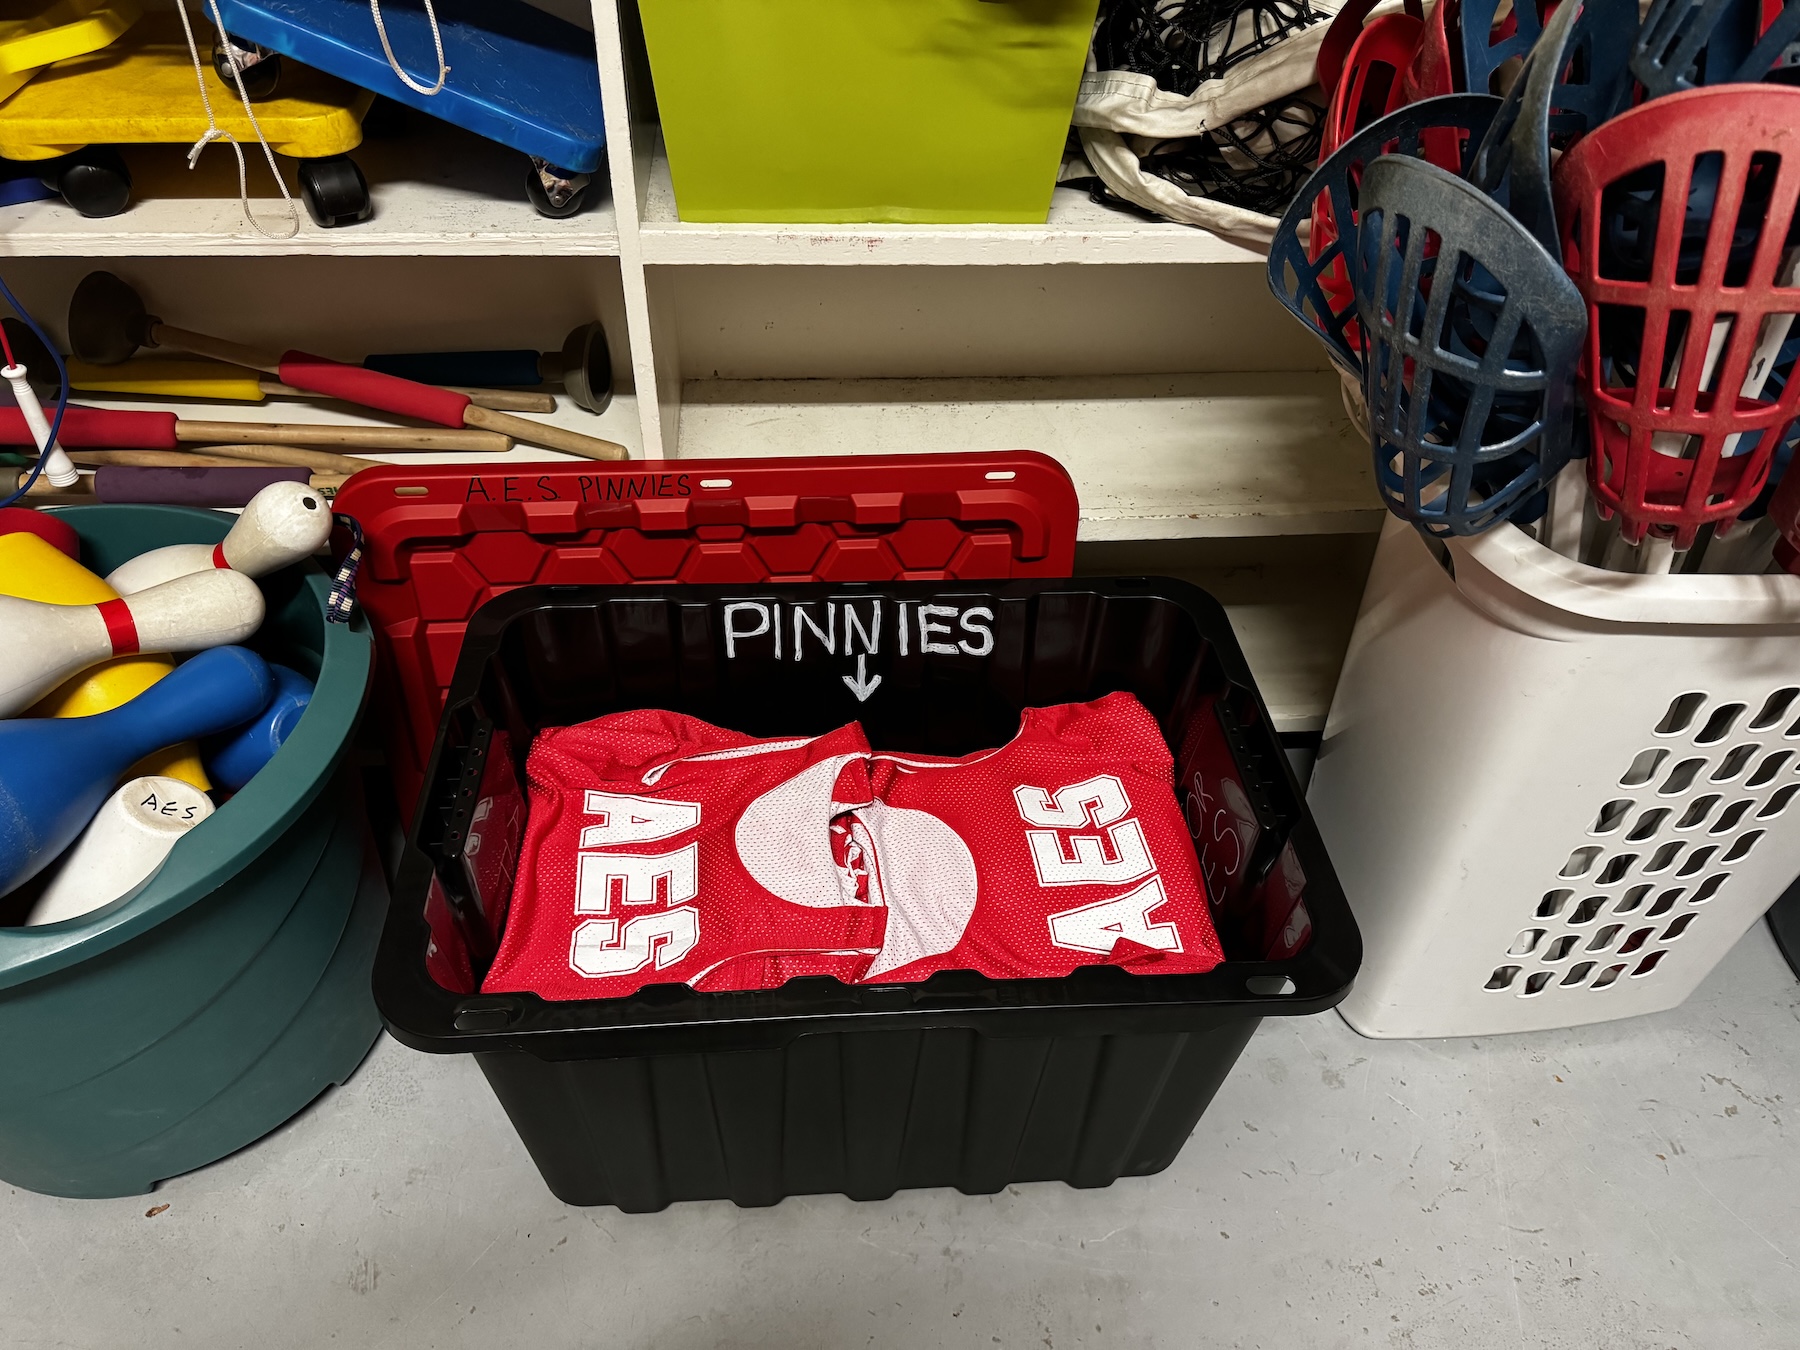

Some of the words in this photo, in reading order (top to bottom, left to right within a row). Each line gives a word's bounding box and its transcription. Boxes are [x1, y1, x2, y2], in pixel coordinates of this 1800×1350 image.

[578, 474, 691, 502] PINNIES
[724, 600, 994, 661] PINNIES
[140, 793, 197, 819] AES
[569, 789, 701, 978] AES
[1012, 773, 1184, 955] AES
